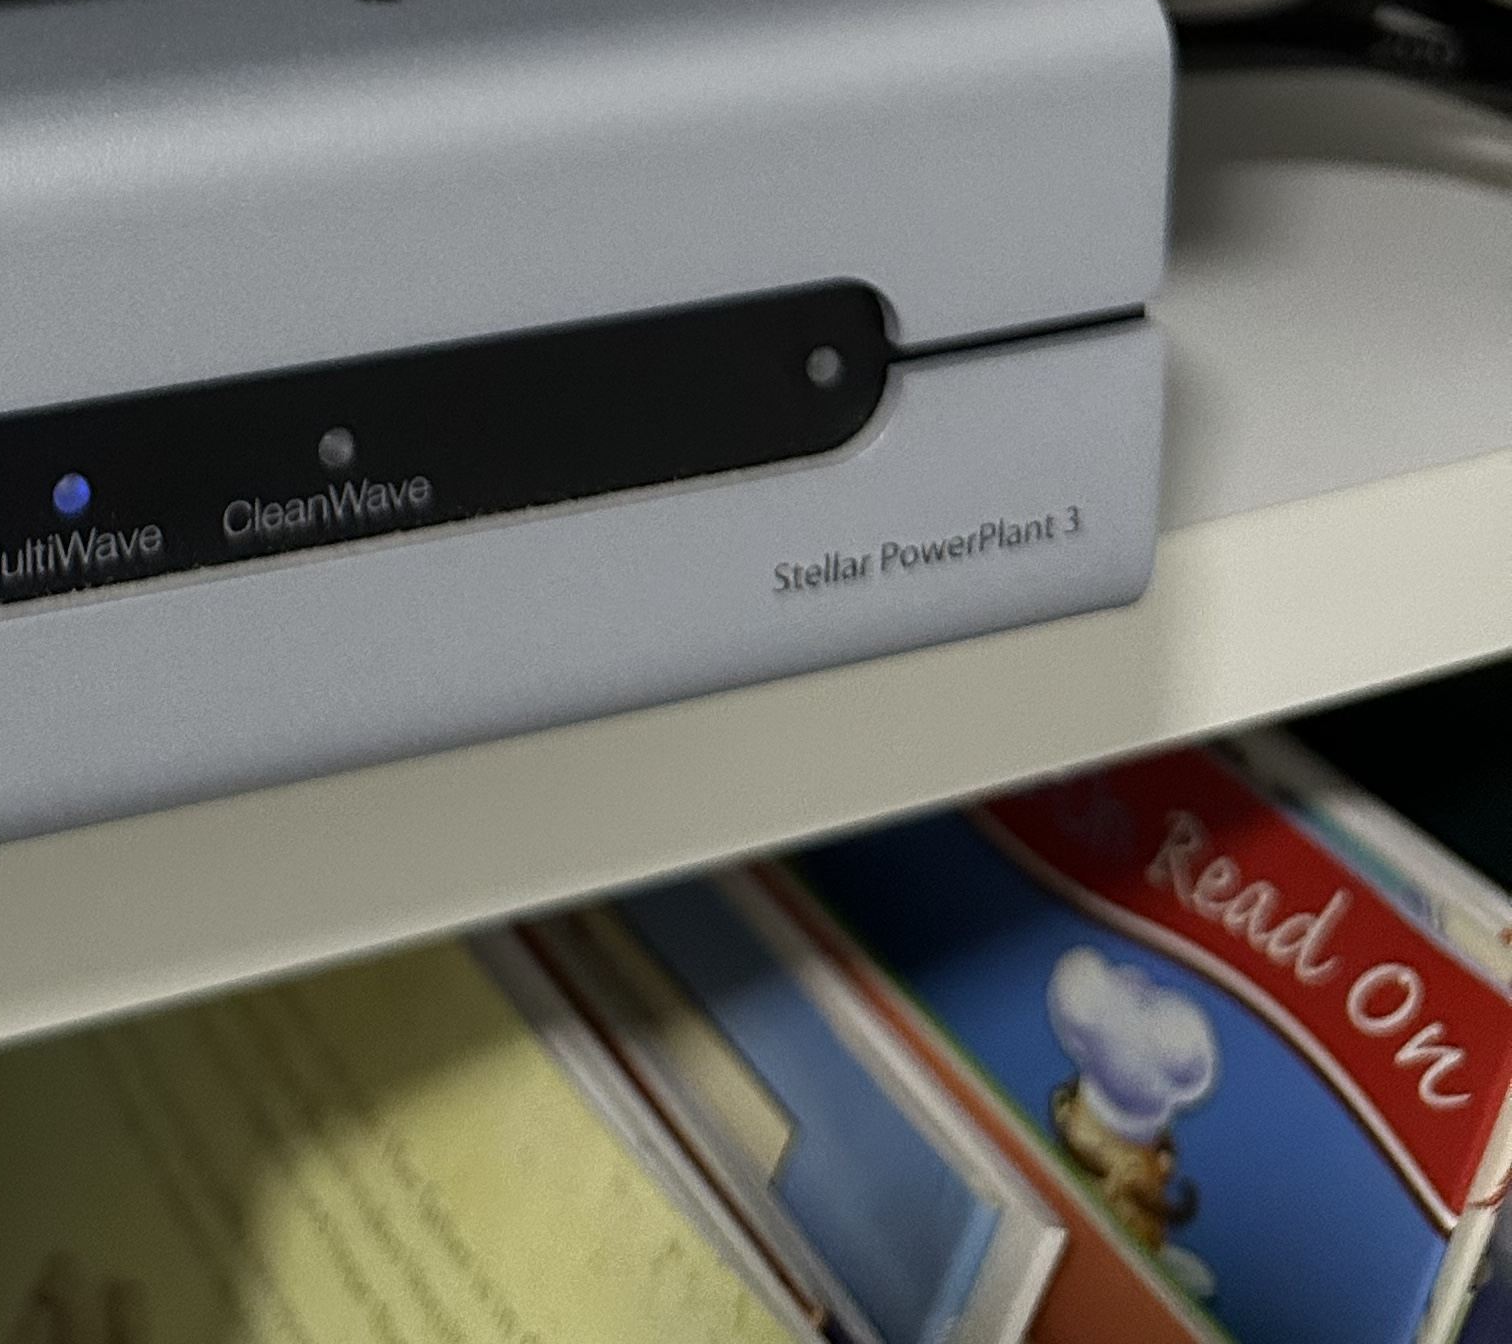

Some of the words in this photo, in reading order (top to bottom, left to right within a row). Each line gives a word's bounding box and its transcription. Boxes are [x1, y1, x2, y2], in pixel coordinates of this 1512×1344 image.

[223, 475, 430, 540] CleanWave
[773, 551, 872, 593] Stellar
[881, 514, 1055, 572] PowerPlant
[1064, 505, 1080, 533] 3
[1144, 811, 1354, 988] Read
[1345, 962, 1473, 1111] On
